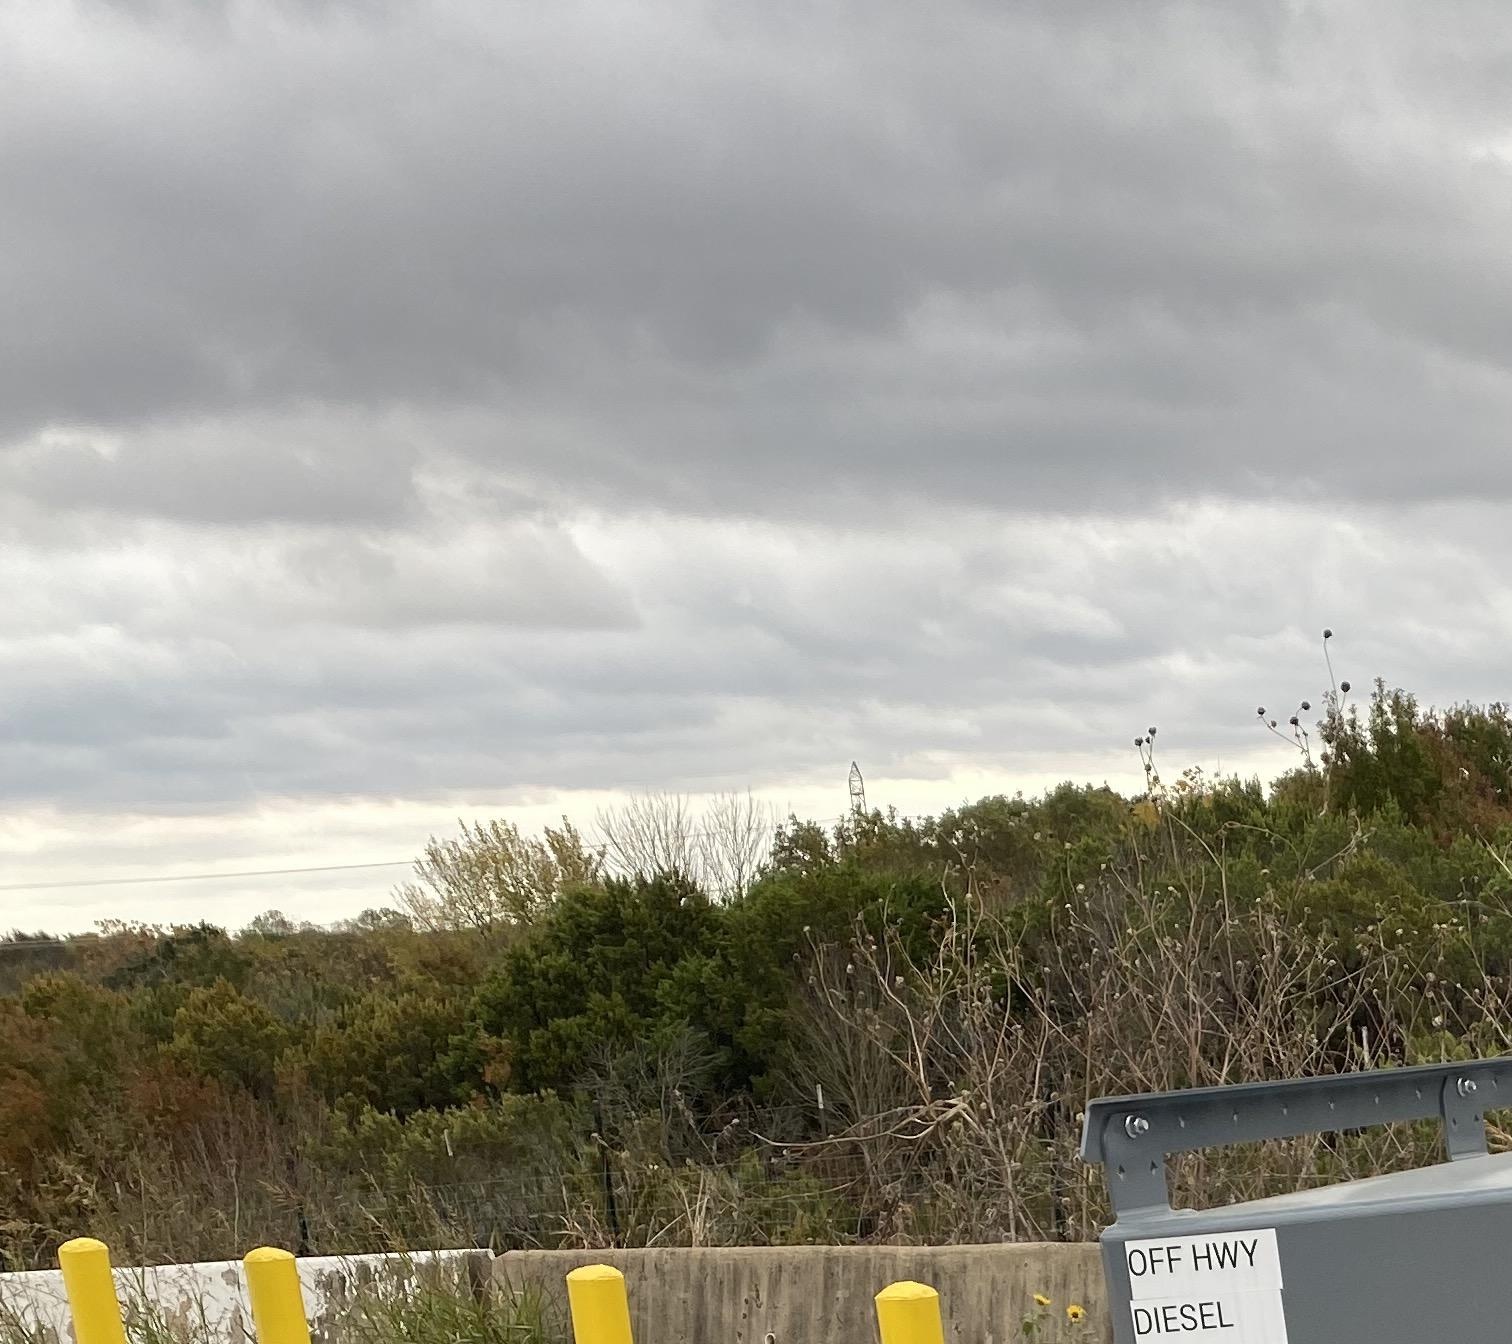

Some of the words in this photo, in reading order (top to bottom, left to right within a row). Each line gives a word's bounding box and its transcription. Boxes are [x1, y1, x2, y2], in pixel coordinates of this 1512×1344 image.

[1128, 1246, 1181, 1276] OFF
[1192, 1239, 1258, 1271] HWY
[1134, 1301, 1234, 1335] DIESEL
